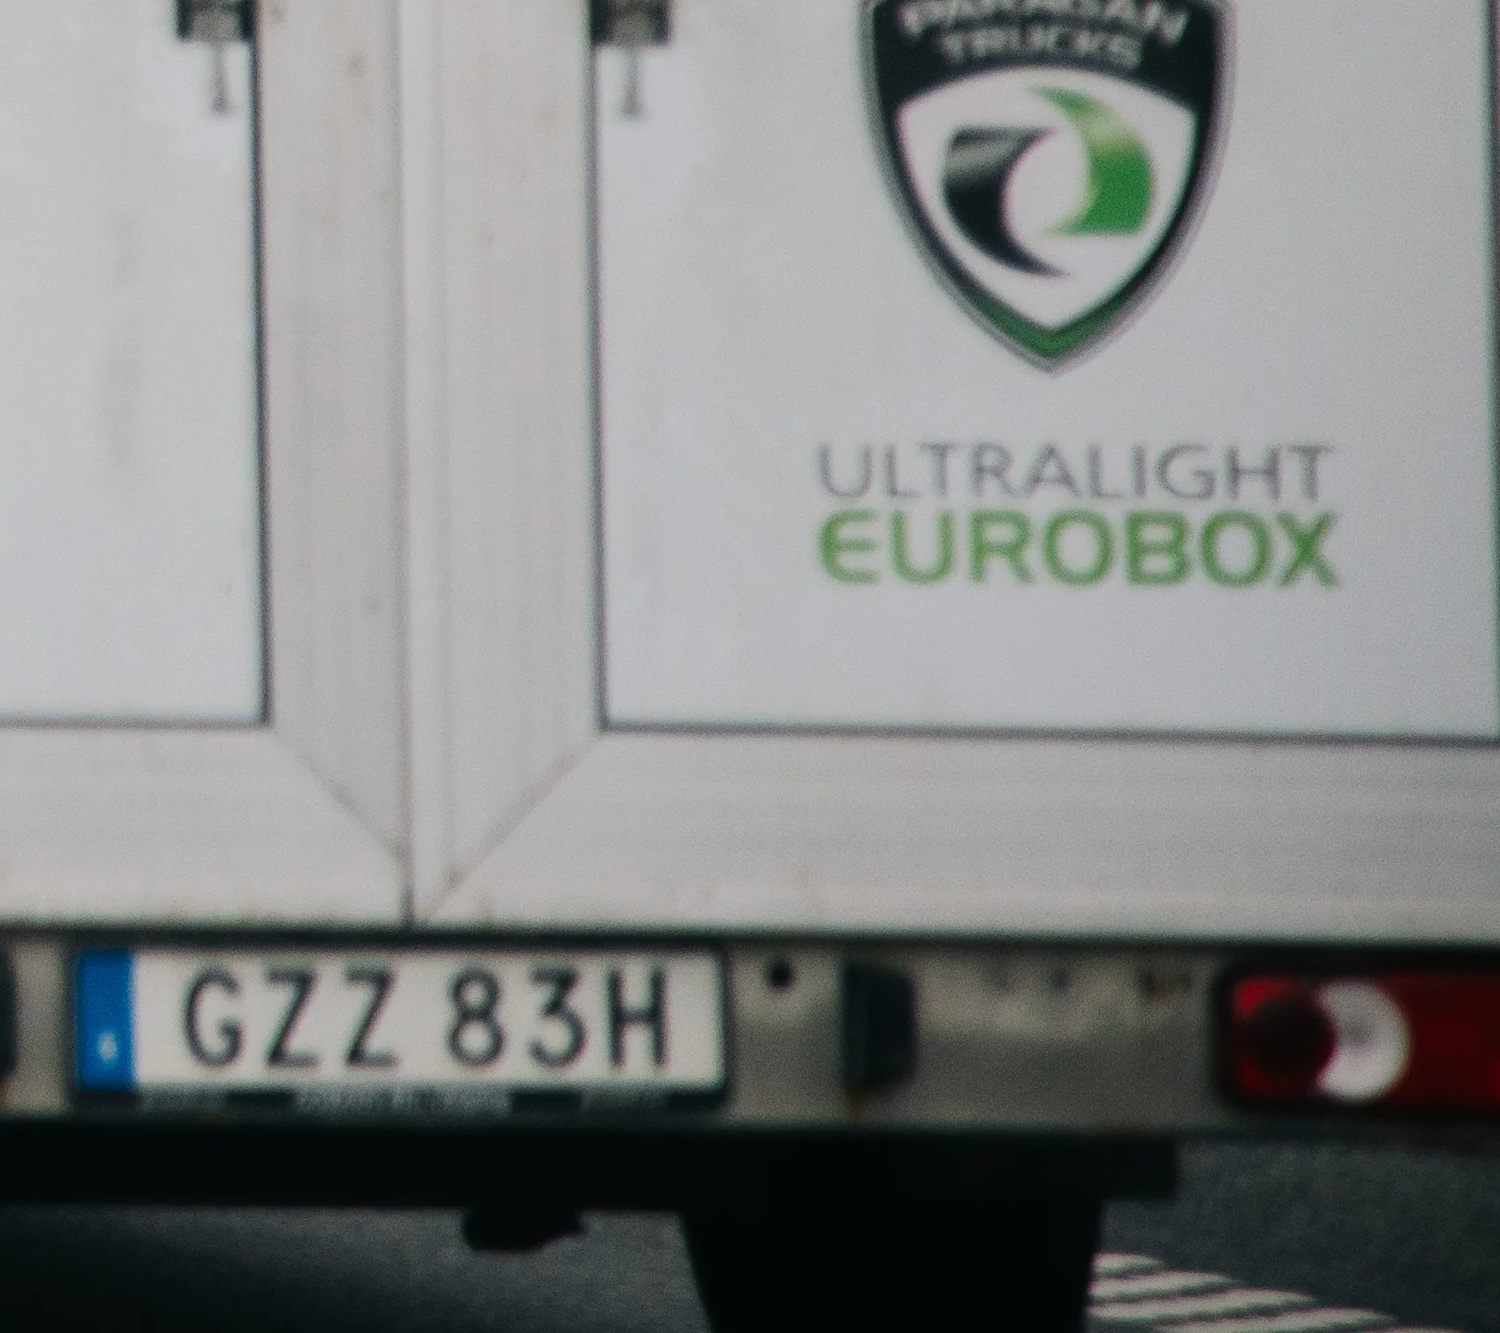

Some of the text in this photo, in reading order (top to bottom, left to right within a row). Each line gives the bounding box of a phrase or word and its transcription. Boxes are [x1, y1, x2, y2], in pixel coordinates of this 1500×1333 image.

[940, 24, 1142, 70] TRUCKS
[816, 440, 1336, 502] ULTRALIGHT
[816, 506, 1339, 589] EUROBOX
[182, 964, 672, 1071] GZZ 83H
